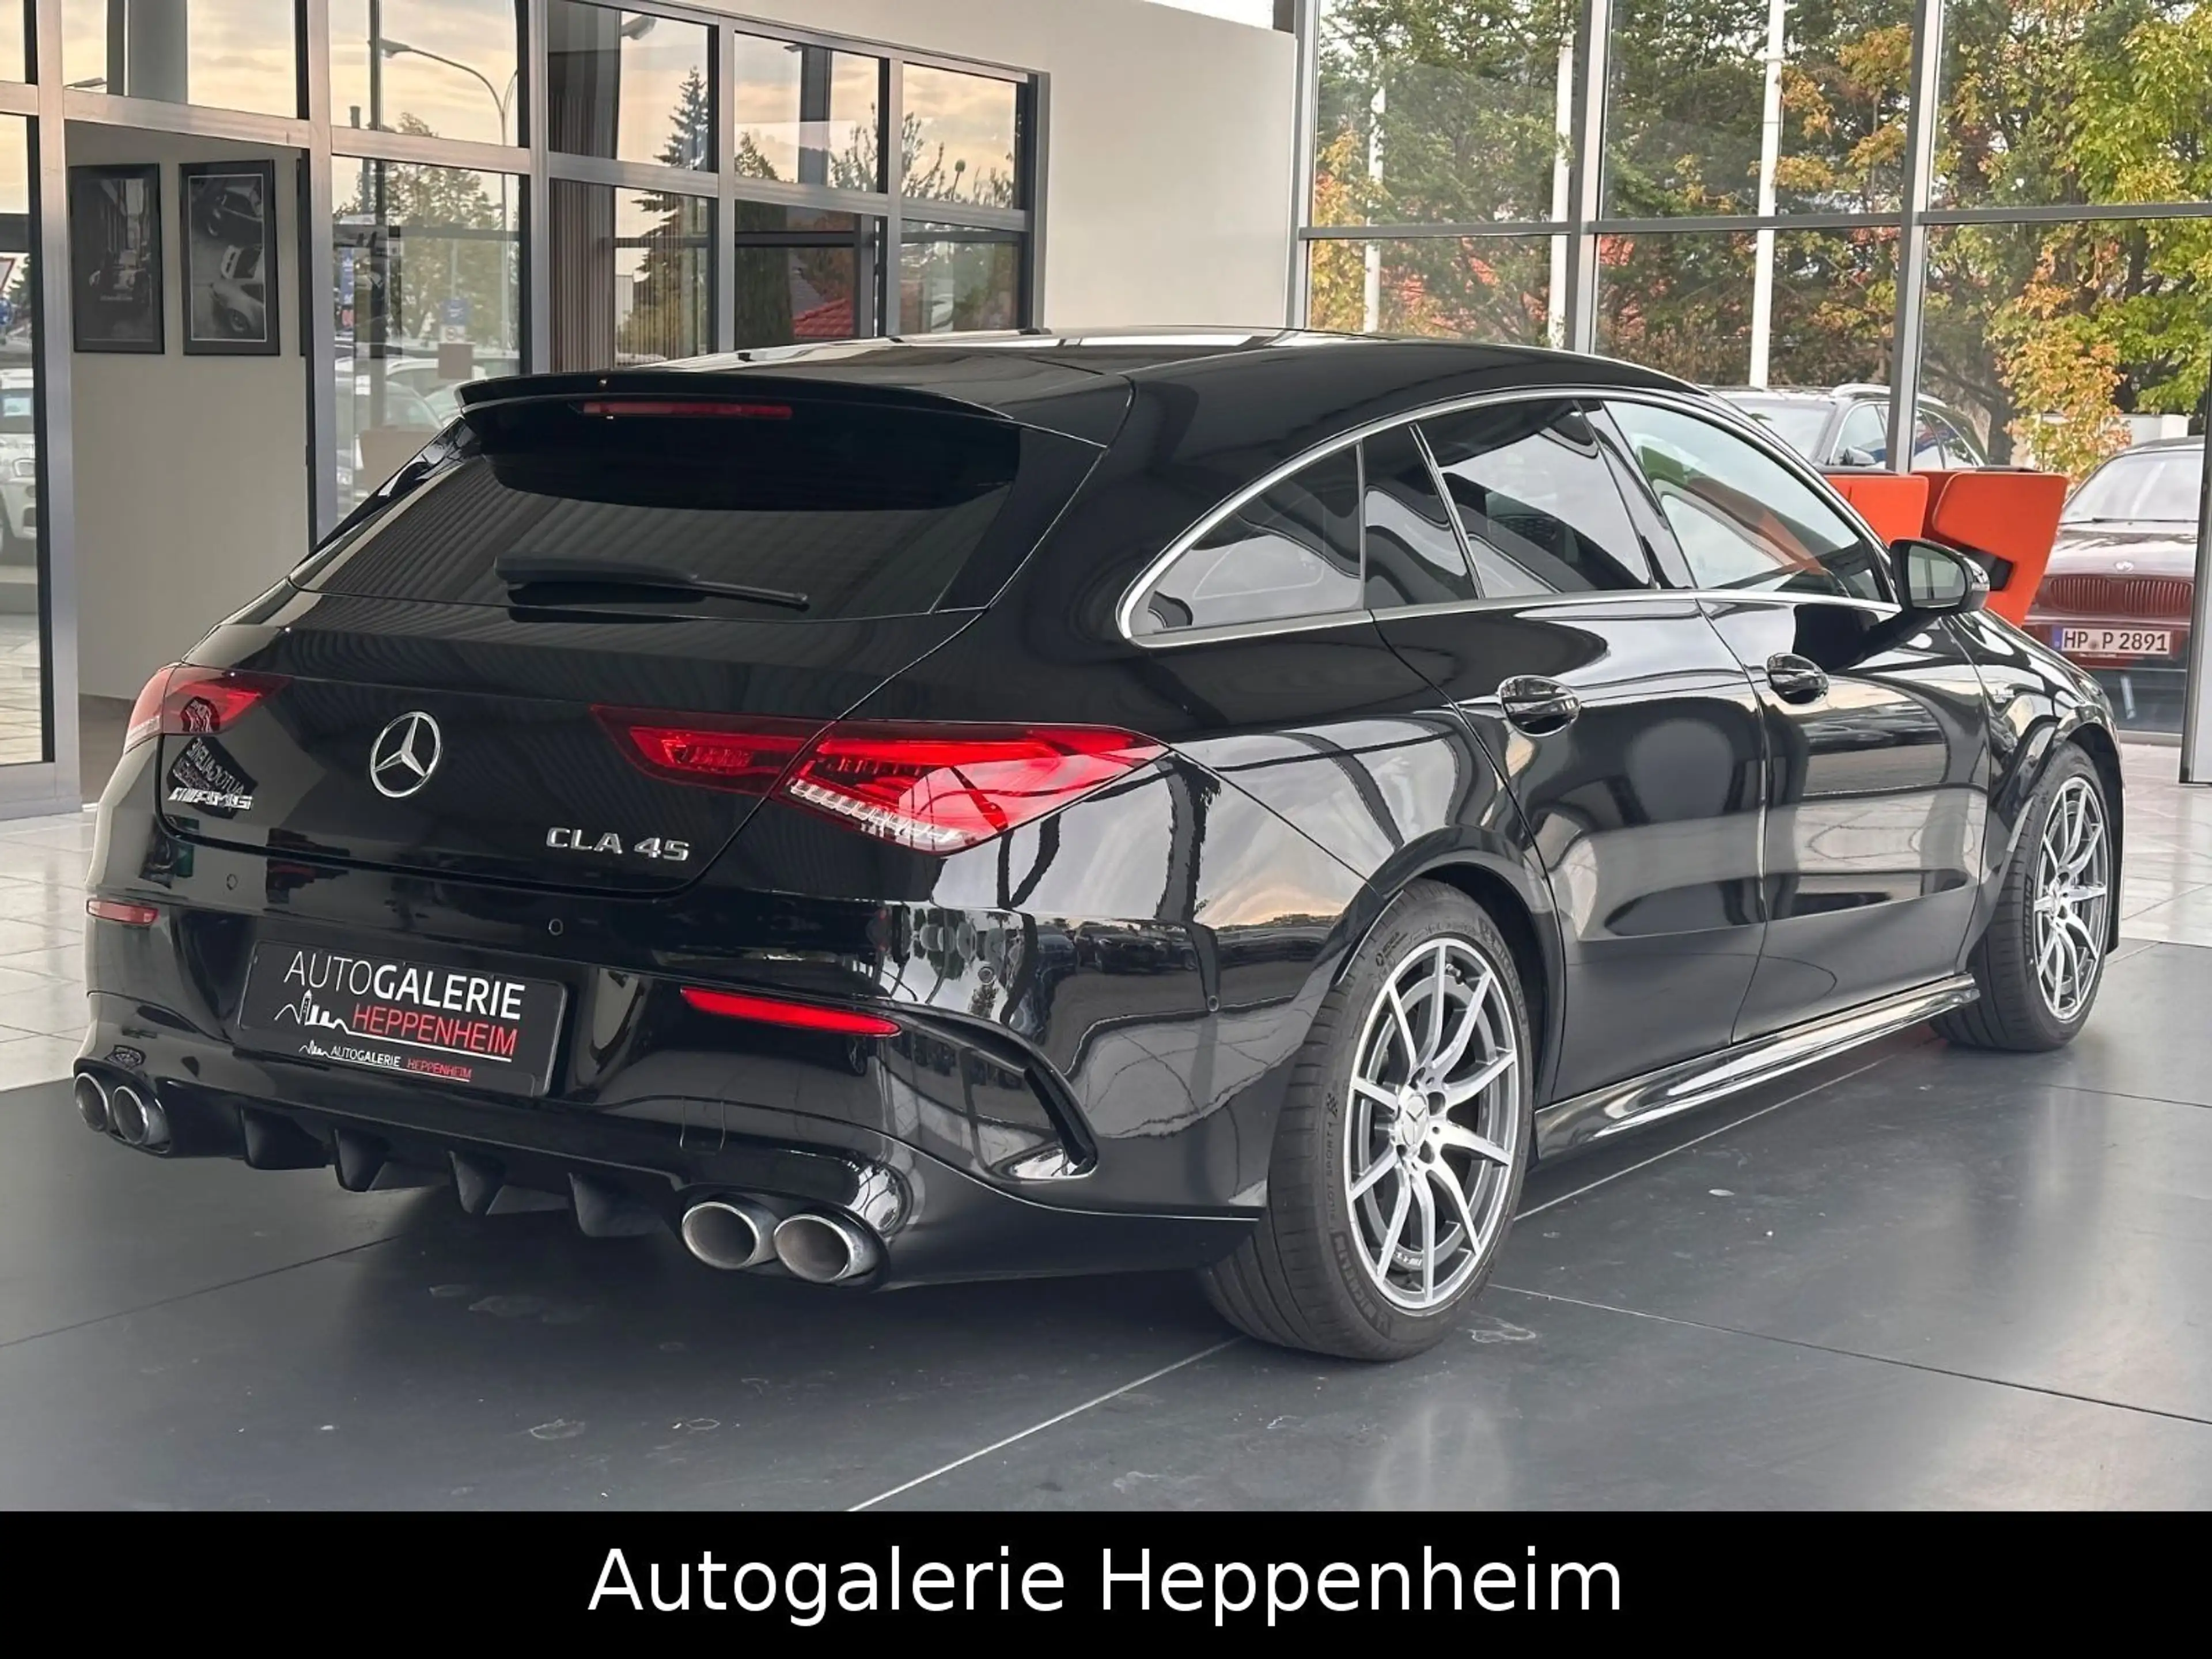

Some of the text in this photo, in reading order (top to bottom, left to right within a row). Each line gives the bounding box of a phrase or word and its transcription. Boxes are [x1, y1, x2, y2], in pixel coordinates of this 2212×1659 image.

[2064, 630, 2167, 652] HP P 2891
[194, 789, 252, 810] AMG
[546, 827, 690, 861] CLA 45
[284, 950, 525, 1020] AUTOGALERIE
[353, 1003, 517, 1056] HEPPENHEIM
[330, 1046, 472, 1080] AUTOGALERIE HEPPENHEIM
[1333, 1234, 1377, 1319] MICHELIN
